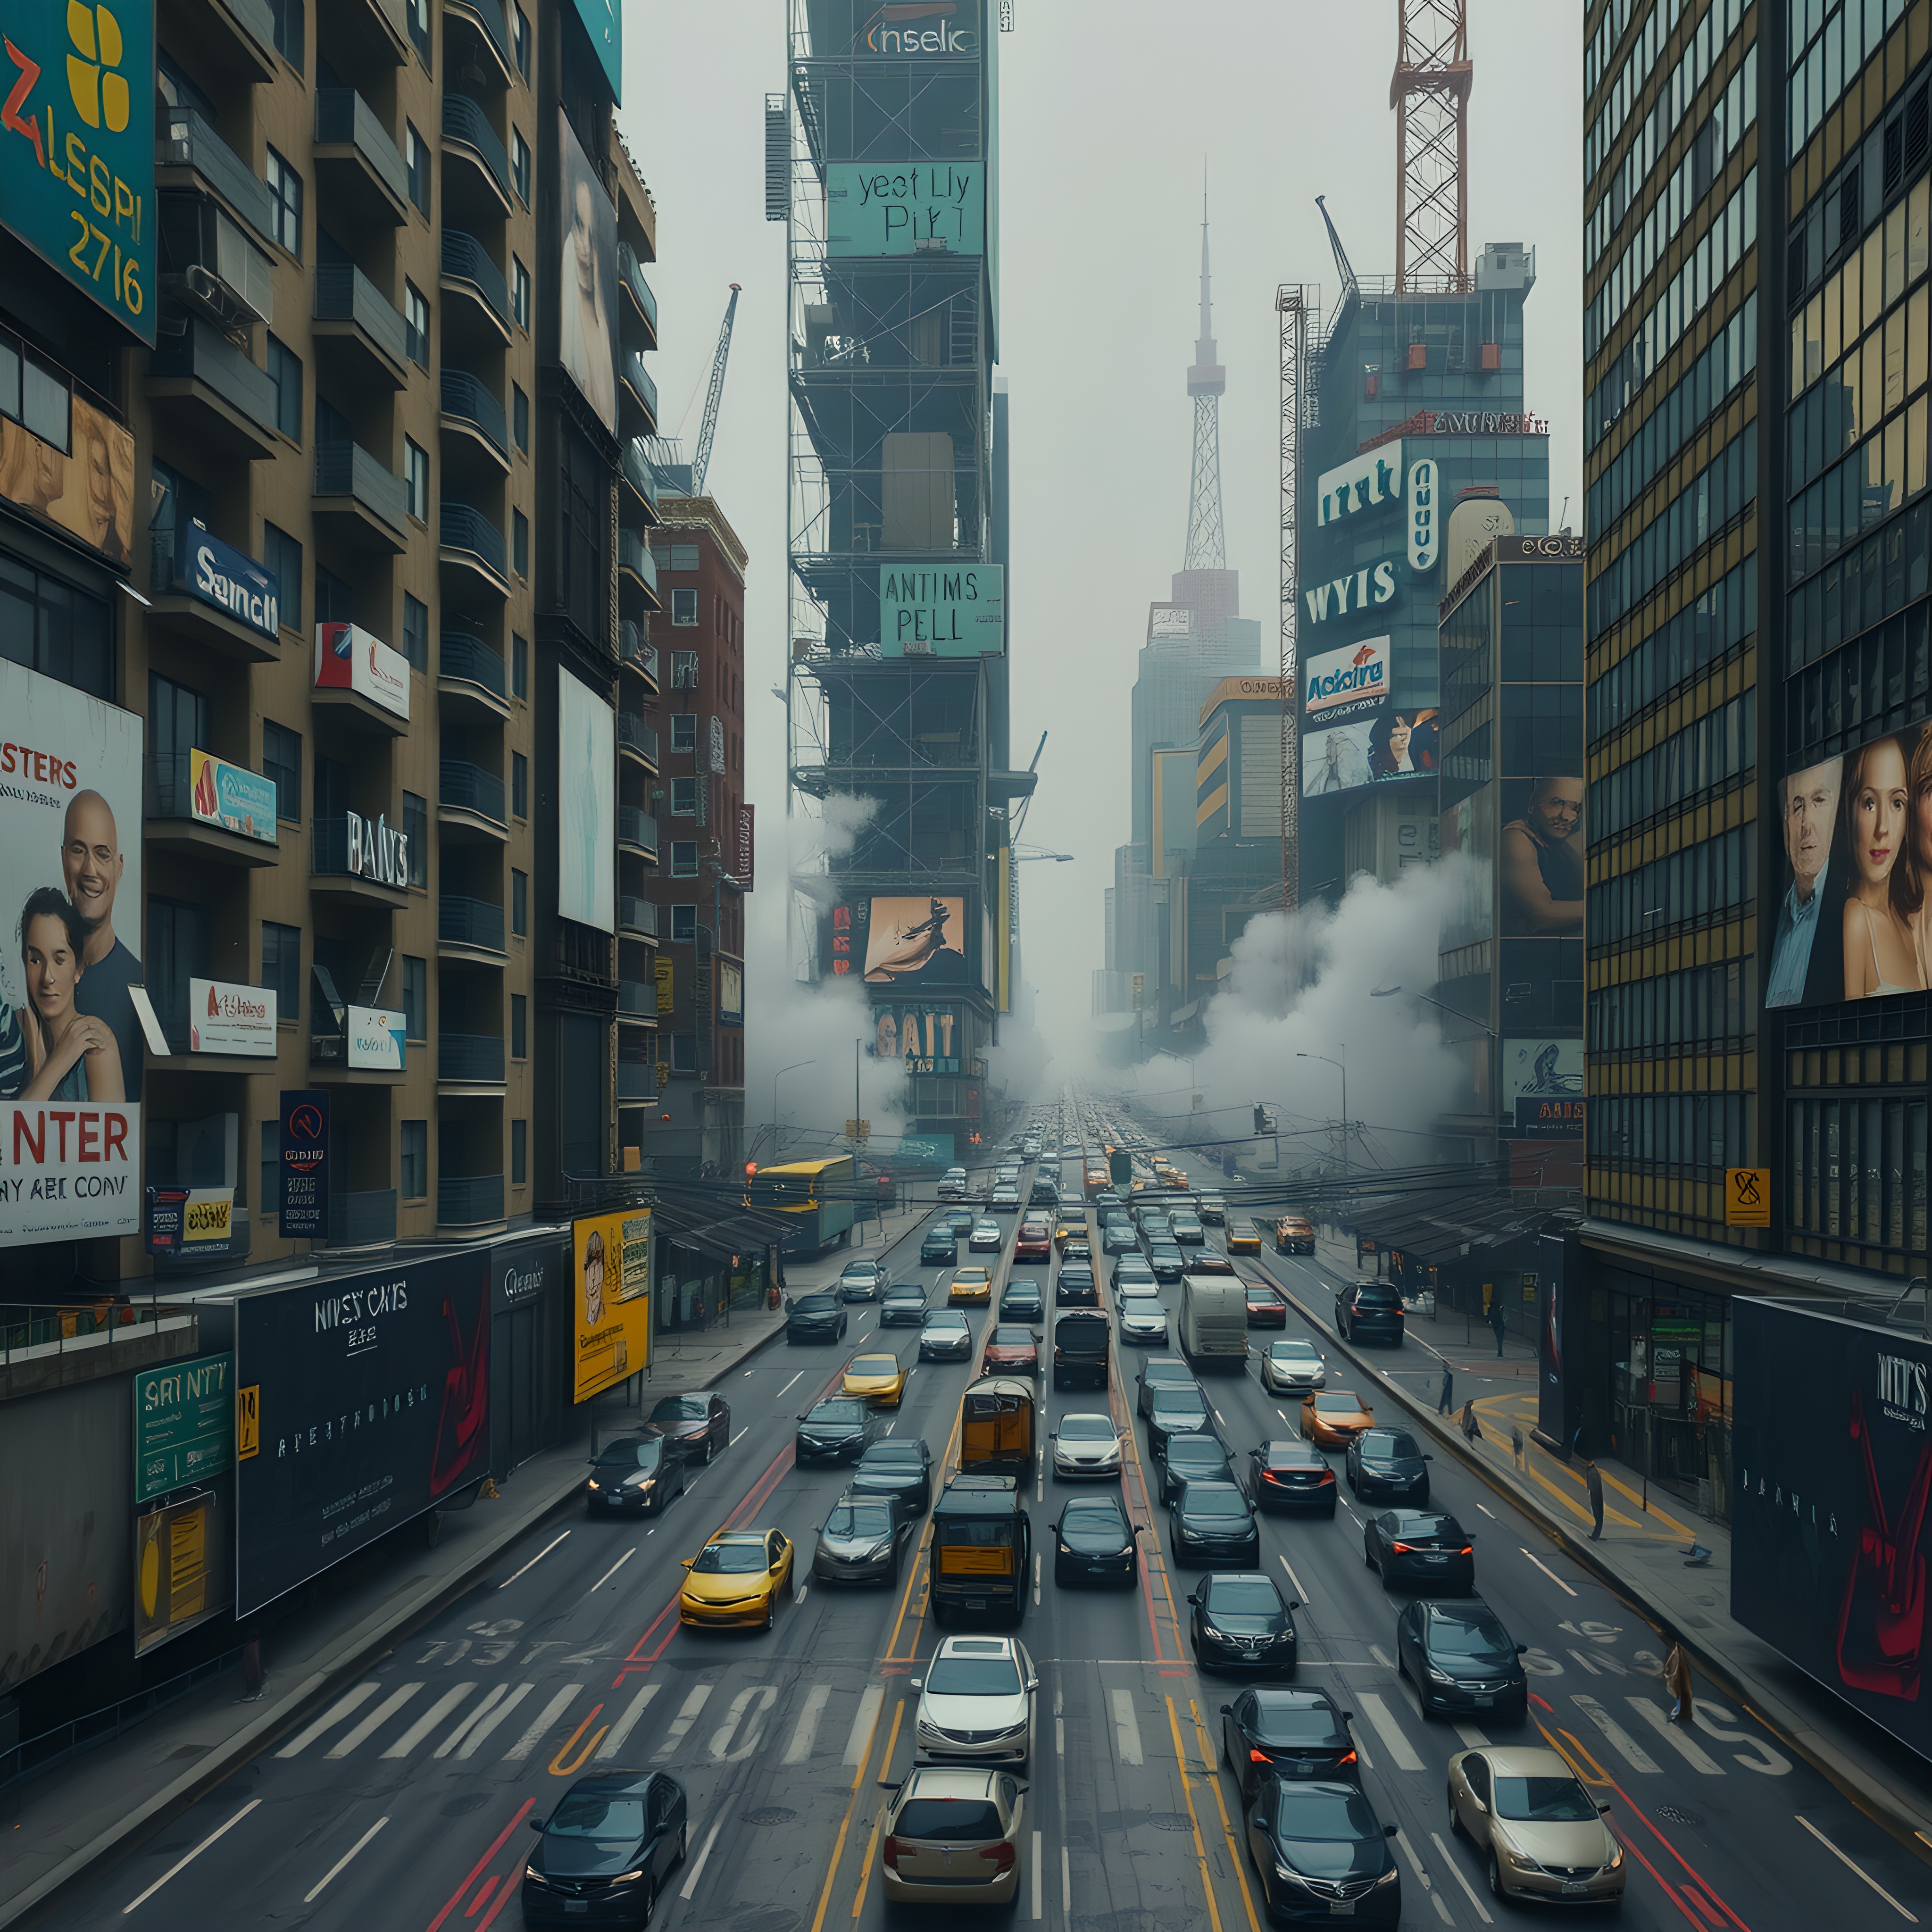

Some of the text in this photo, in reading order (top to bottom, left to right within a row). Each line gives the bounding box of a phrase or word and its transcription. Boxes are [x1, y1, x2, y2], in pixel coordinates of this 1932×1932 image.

[69, 210, 142, 315] 2716
[886, 573, 977, 603] ANTIMS
[14, 1110, 128, 1165] NTER
